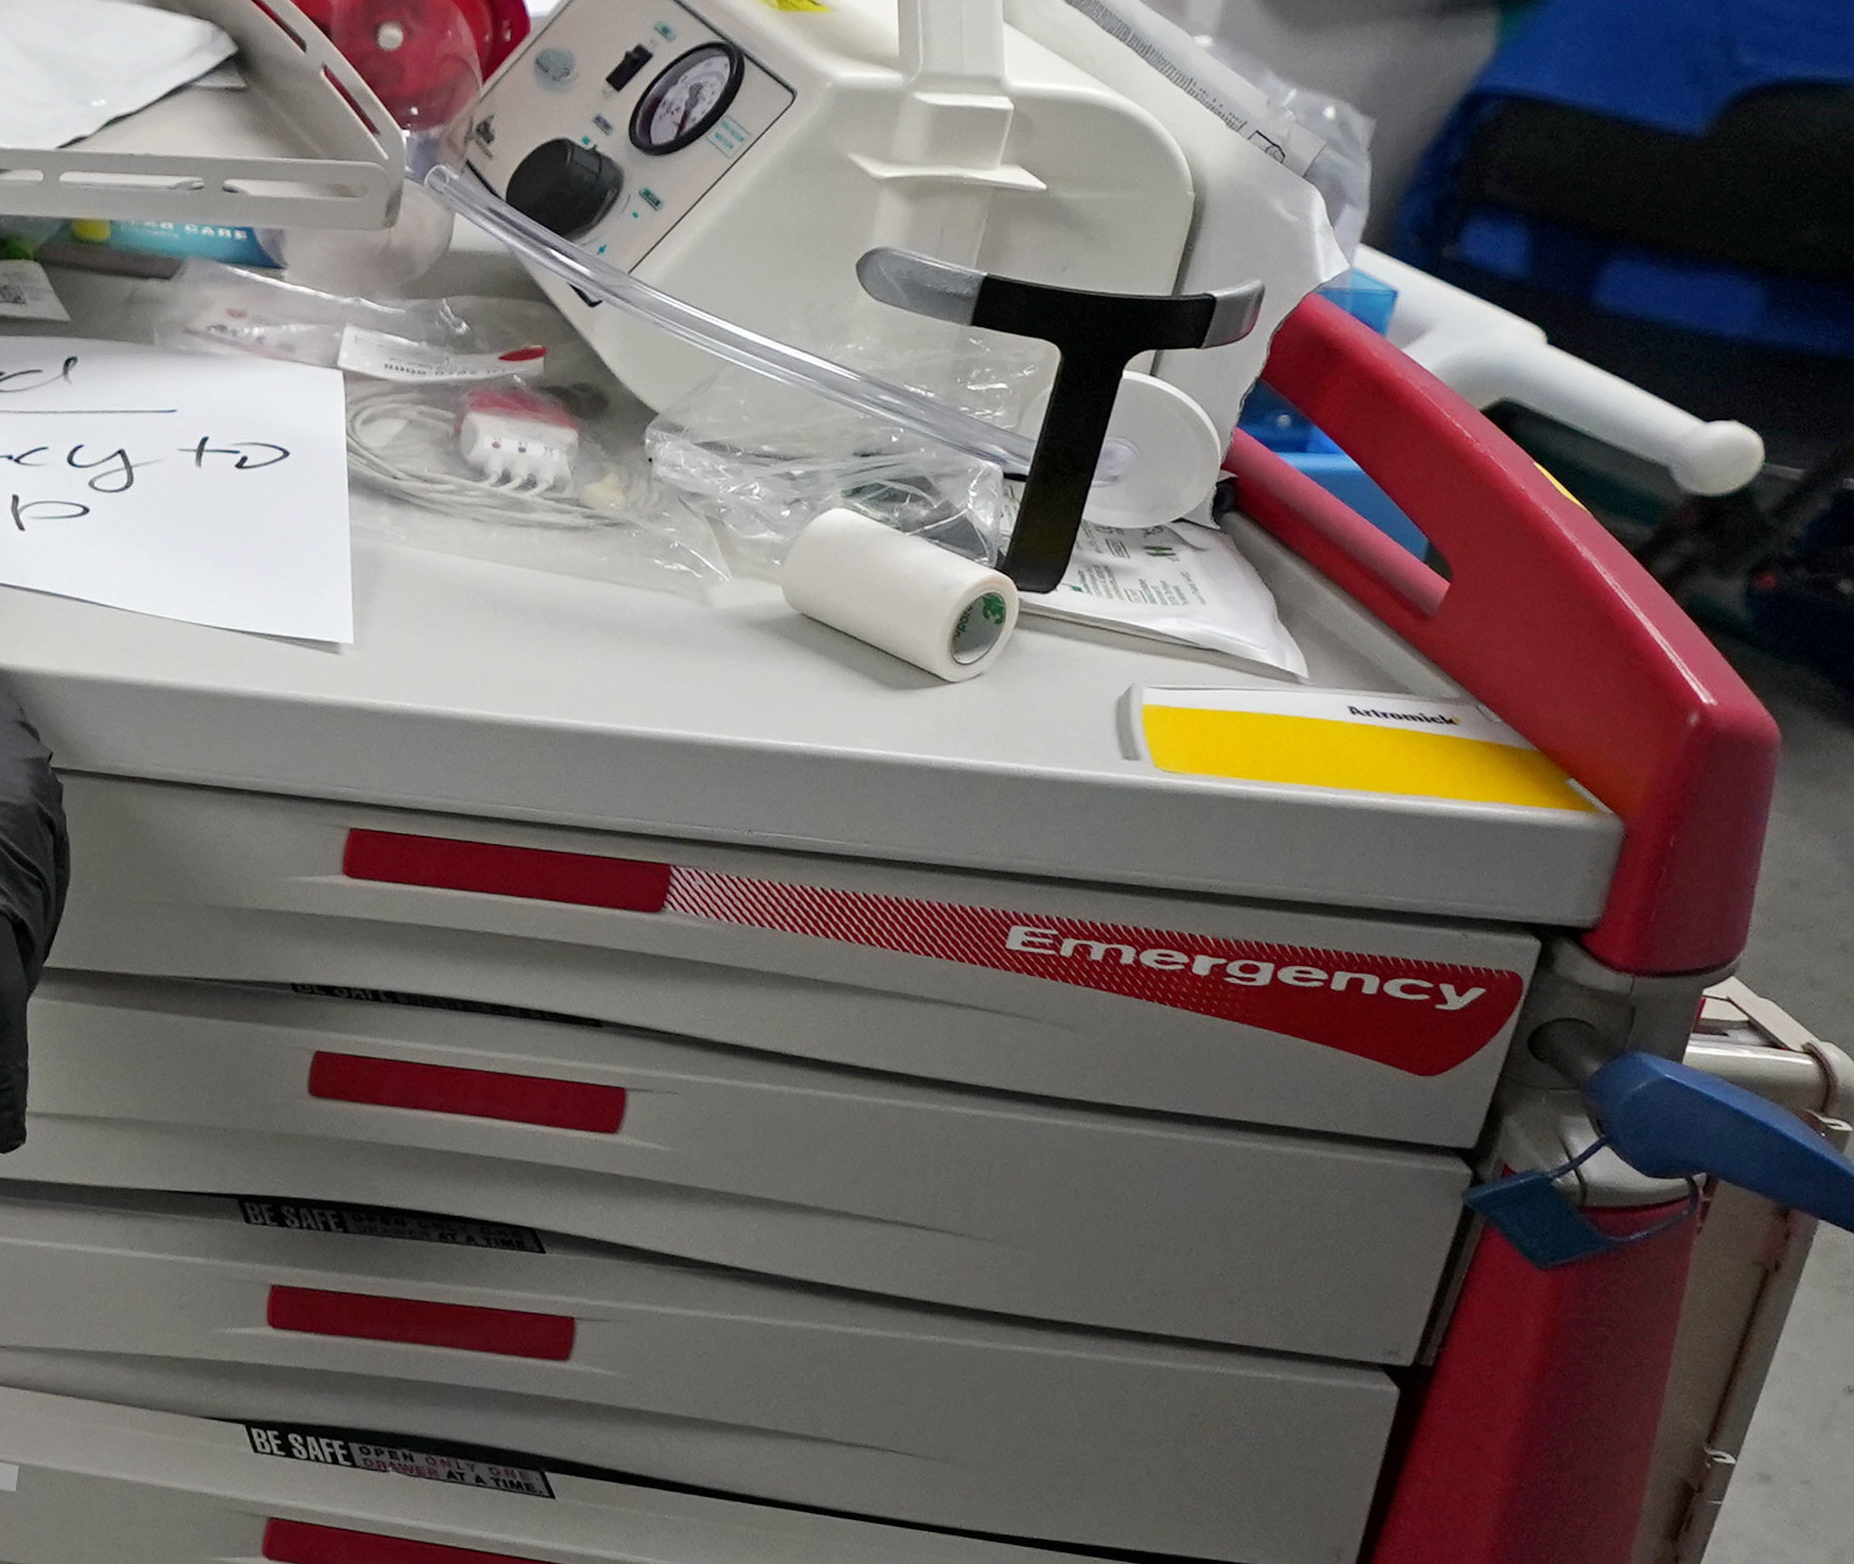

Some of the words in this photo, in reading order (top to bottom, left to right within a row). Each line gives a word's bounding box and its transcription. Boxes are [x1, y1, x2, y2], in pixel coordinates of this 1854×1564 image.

[177, 436, 291, 470] to
[1347, 705, 1458, 726] Artromick
[1004, 924, 1487, 1011] Emergency
[244, 1201, 277, 1227] BE
[284, 1204, 343, 1232] SAFE
[250, 1427, 286, 1456] BE
[288, 1433, 353, 1466] SAFE
[359, 1446, 415, 1463] OPEN
[446, 1469, 466, 1482] AT
[474, 1474, 487, 1485] A
